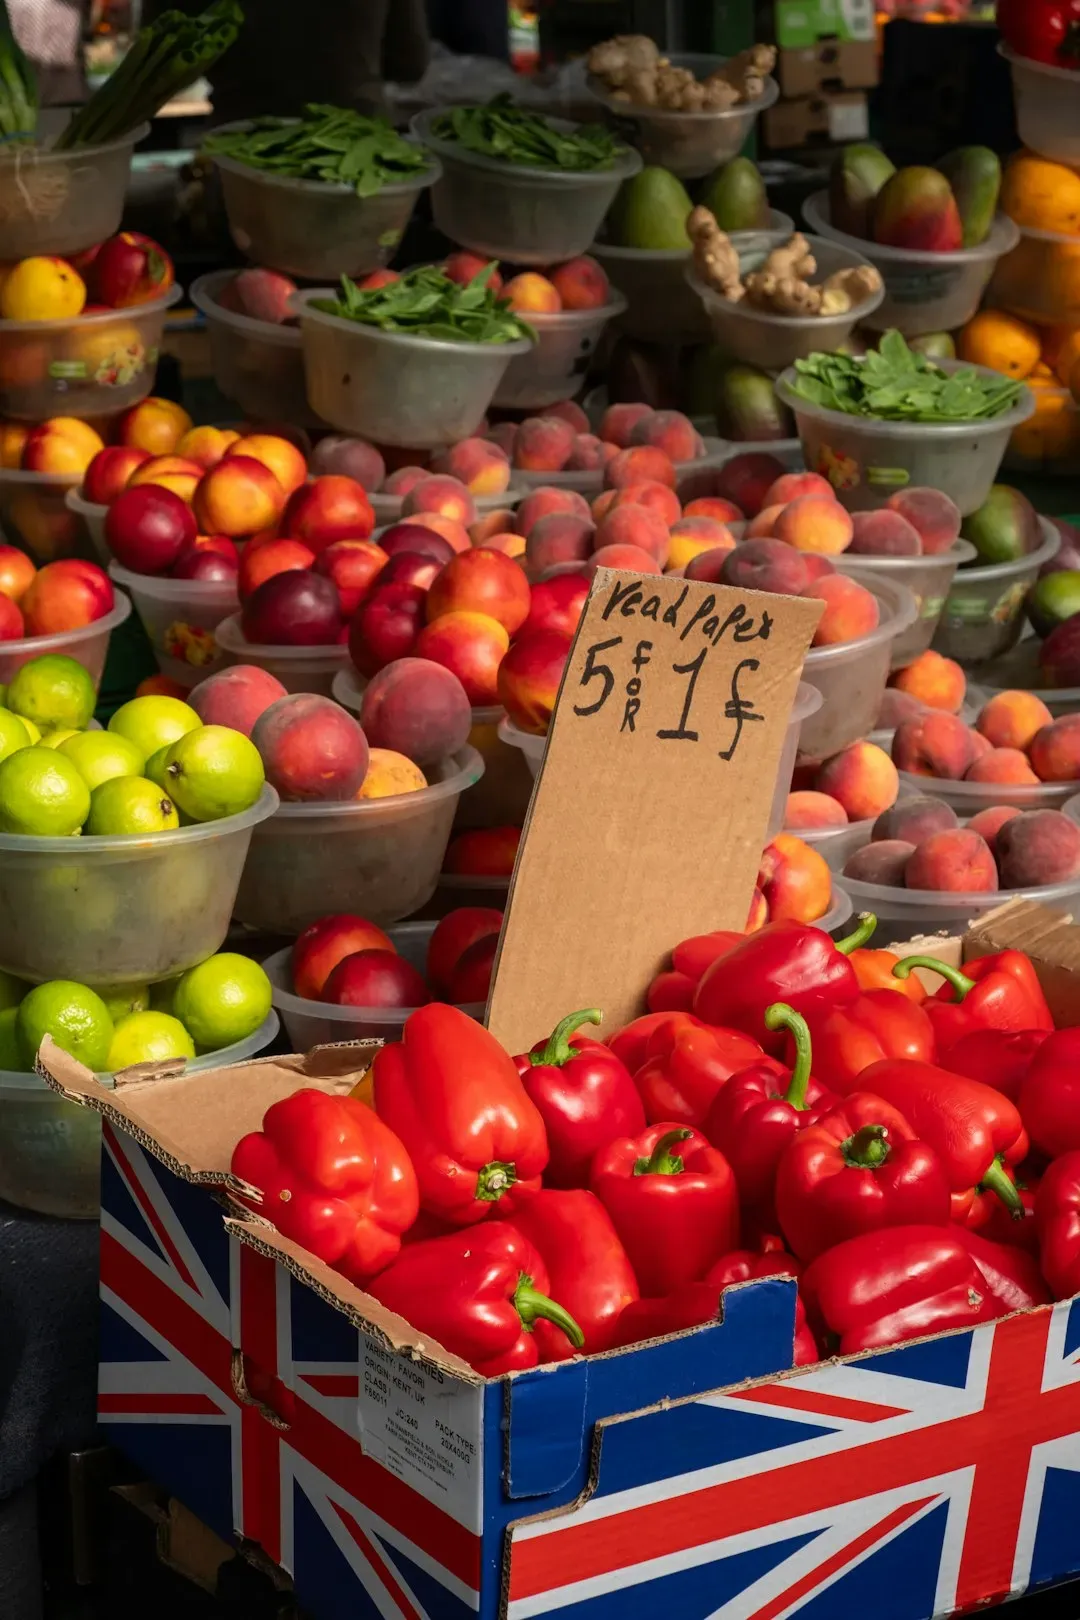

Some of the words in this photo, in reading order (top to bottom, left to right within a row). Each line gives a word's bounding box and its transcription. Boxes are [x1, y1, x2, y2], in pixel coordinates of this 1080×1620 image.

[573, 636, 623, 716] 5
[656, 647, 707, 742] 1
[365, 1339, 396, 1368] VARIETY:
[399, 1362, 425, 1389] FAVORI
[365, 1355, 391, 1382] ORIGIN:
[415, 1391, 425, 1405] UK
[365, 1371, 387, 1394] CLASS
[435, 1419, 455, 1441] PACK
[456, 1433, 477, 1456] TYPE:
